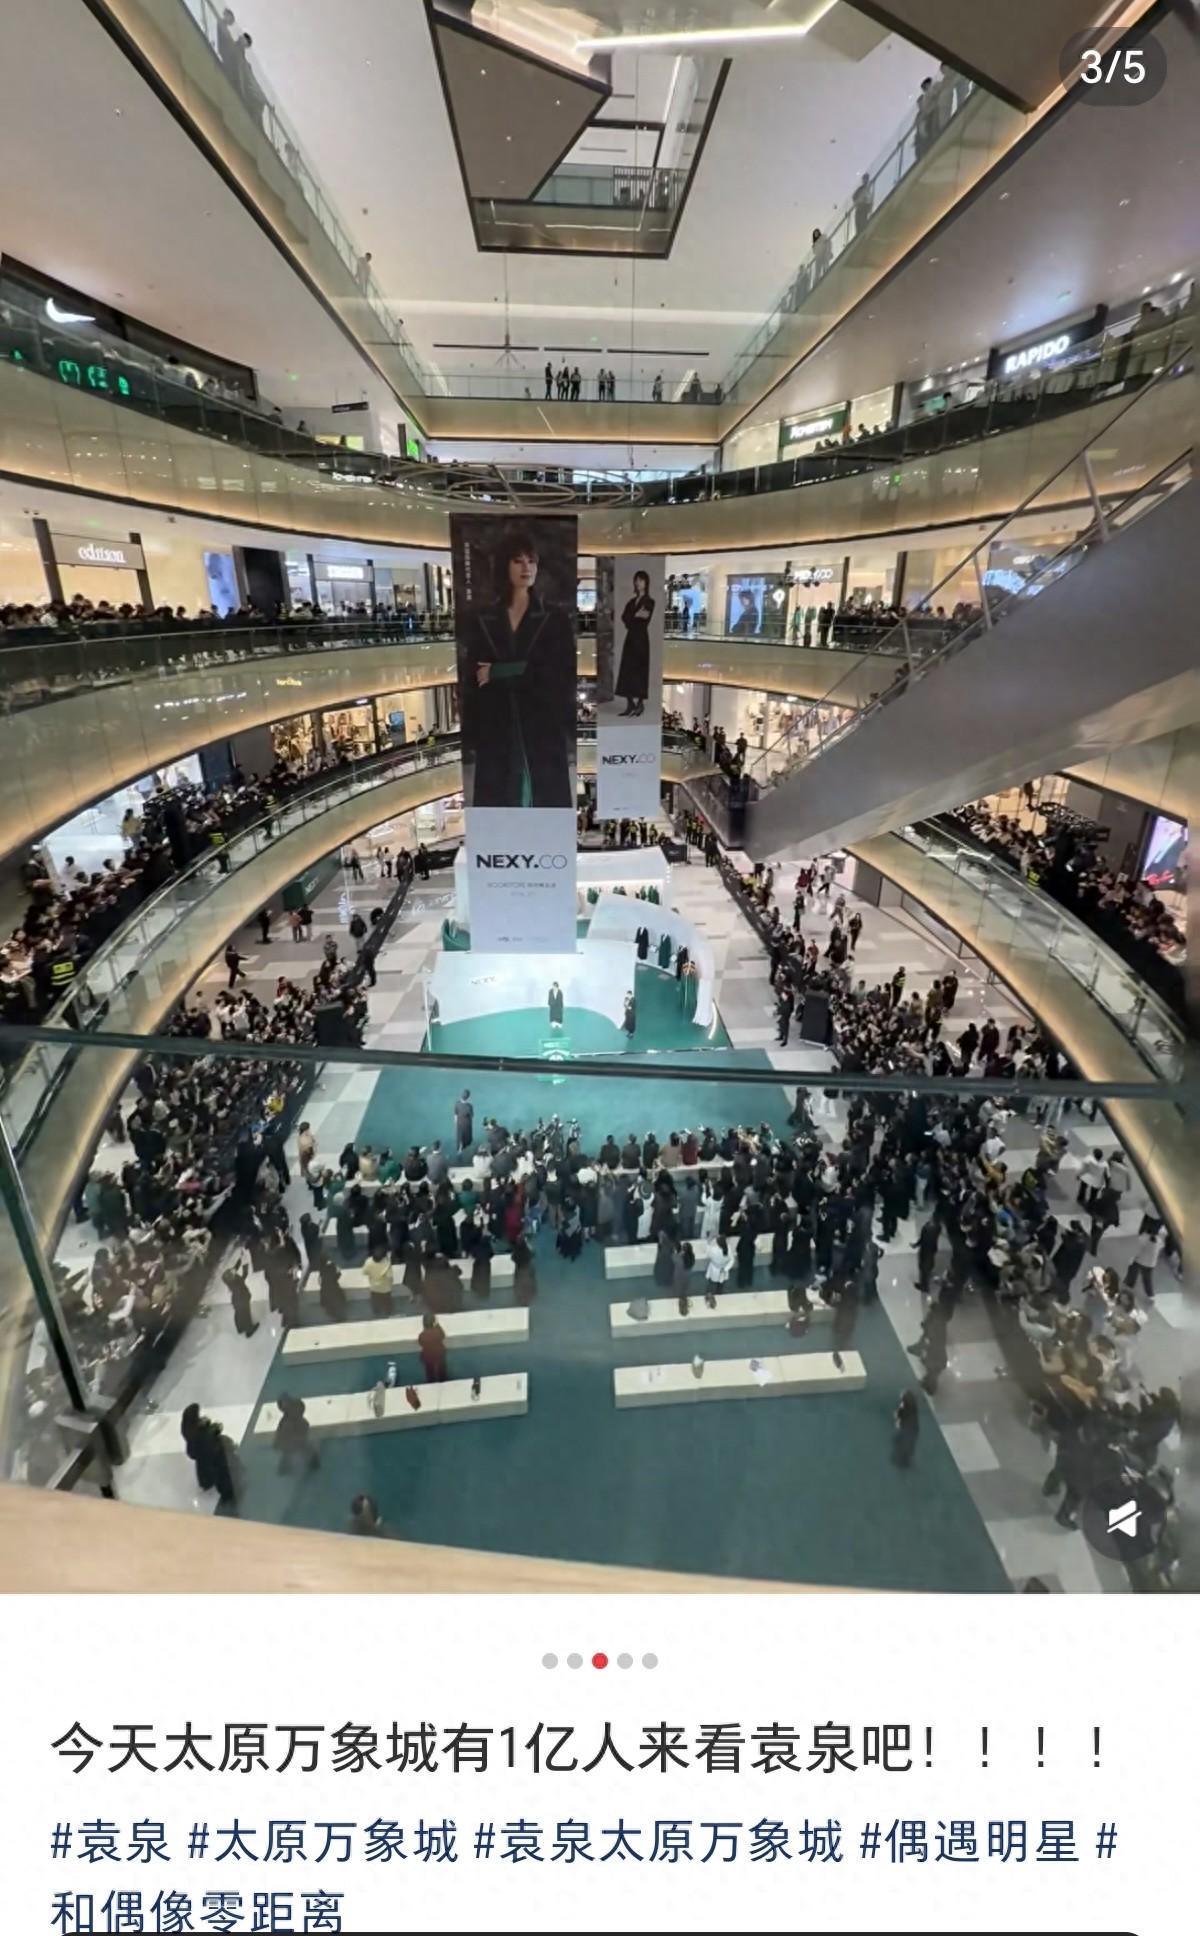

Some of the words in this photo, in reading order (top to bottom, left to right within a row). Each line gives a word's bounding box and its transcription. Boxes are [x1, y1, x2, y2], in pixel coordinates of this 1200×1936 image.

[1004, 335, 1070, 374] RAPIDO
[601, 753, 656, 765] NEXY.CO
[476, 854, 568, 870] NEXY.CO
